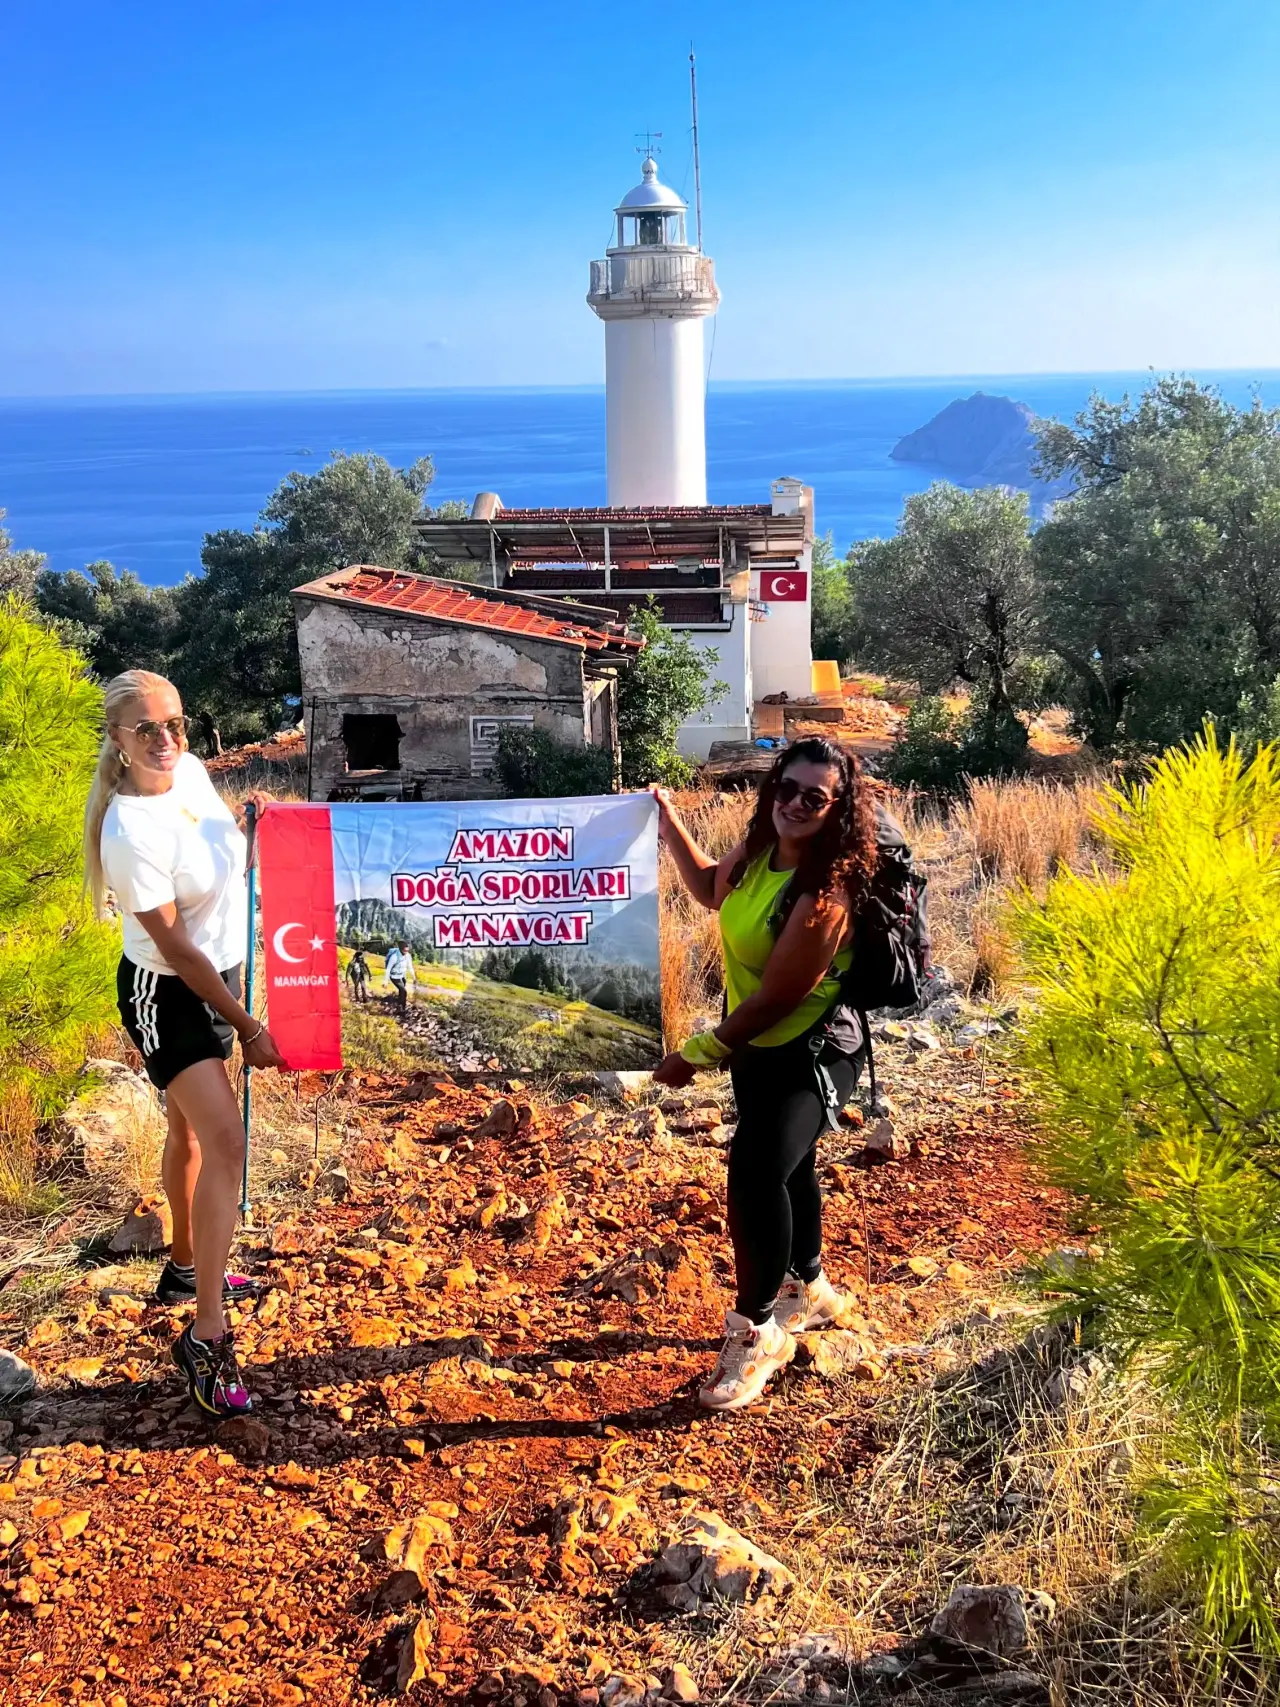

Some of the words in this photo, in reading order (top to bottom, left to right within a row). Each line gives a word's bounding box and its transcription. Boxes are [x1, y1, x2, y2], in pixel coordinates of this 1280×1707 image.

[450, 829, 571, 861] AMAZON
[394, 869, 478, 904] DOĞA
[481, 868, 627, 902] SPORLARI
[436, 913, 589, 945] MANAVGAT
[273, 975, 330, 987] MANAVGAT
